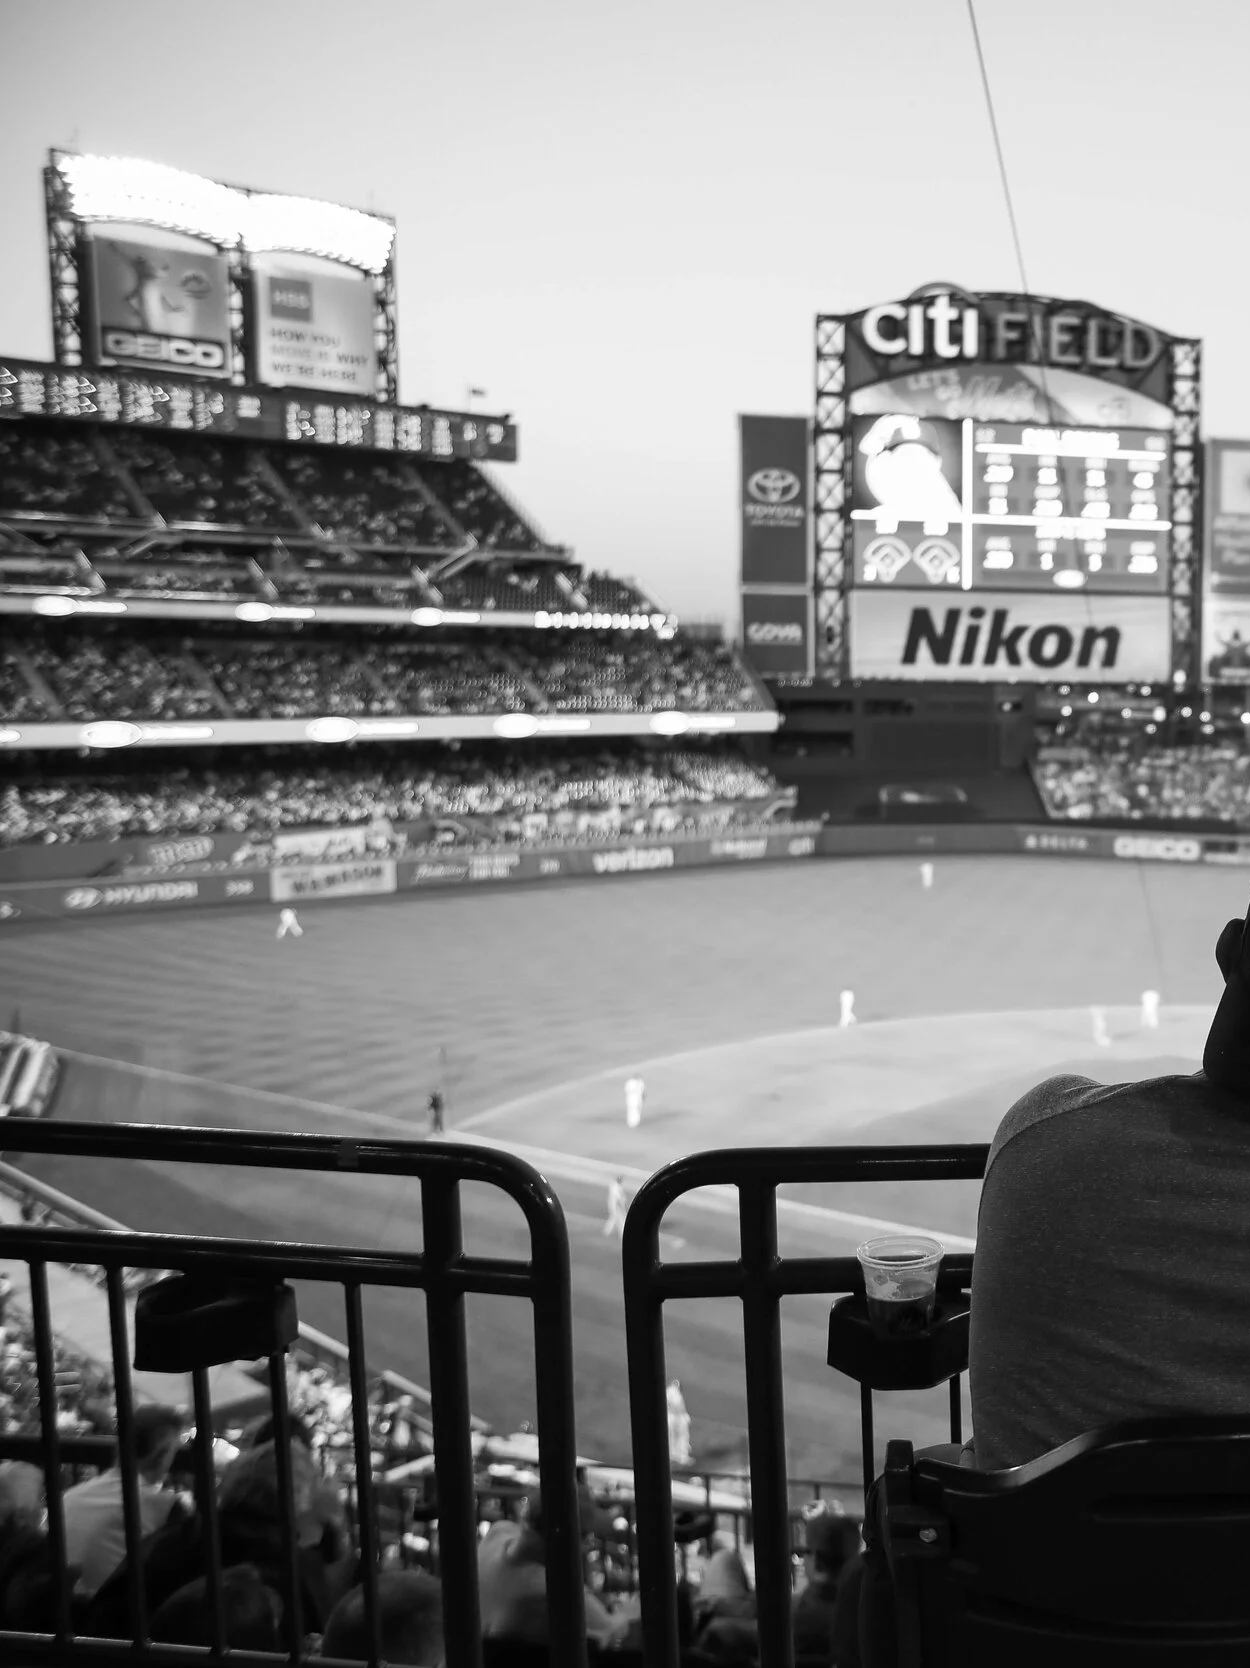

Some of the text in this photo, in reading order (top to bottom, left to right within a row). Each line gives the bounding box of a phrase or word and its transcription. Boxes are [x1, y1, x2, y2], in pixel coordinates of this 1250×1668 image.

[862, 295, 1161, 369] citi FIELD
[105, 332, 224, 368] GEICO
[744, 502, 804, 518] TOYOTA
[902, 606, 1122, 669] Nikon
[593, 846, 675, 873] verizon
[1113, 835, 1201, 861] GEICO
[102, 880, 199, 906] HYUNDAI
